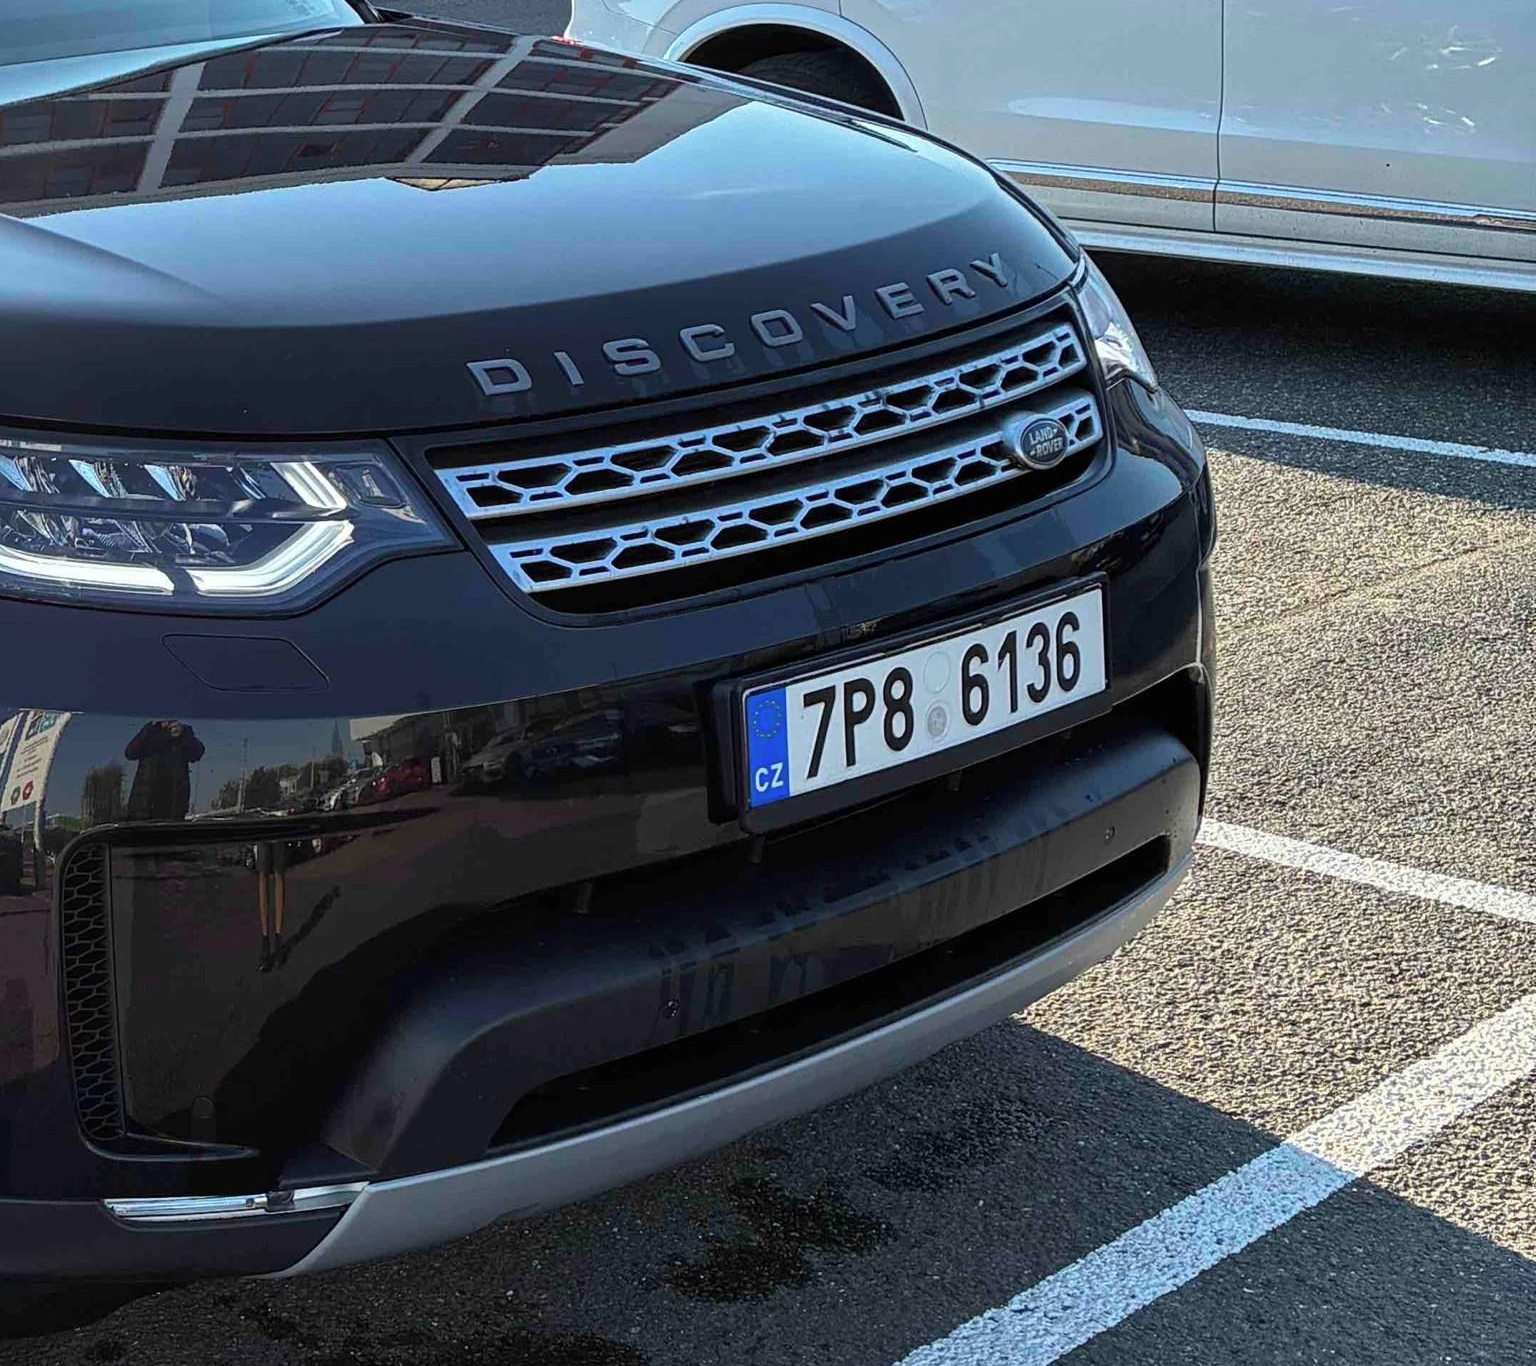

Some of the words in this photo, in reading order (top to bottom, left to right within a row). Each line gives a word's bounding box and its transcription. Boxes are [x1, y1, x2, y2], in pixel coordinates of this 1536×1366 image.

[466, 252, 1009, 397] DISCOVERY
[1028, 426, 1053, 445] LAND
[1036, 437, 1063, 457] ROVER
[754, 762, 784, 793] CZ
[802, 666, 915, 781] 7P8
[960, 610, 1081, 727] 6136
